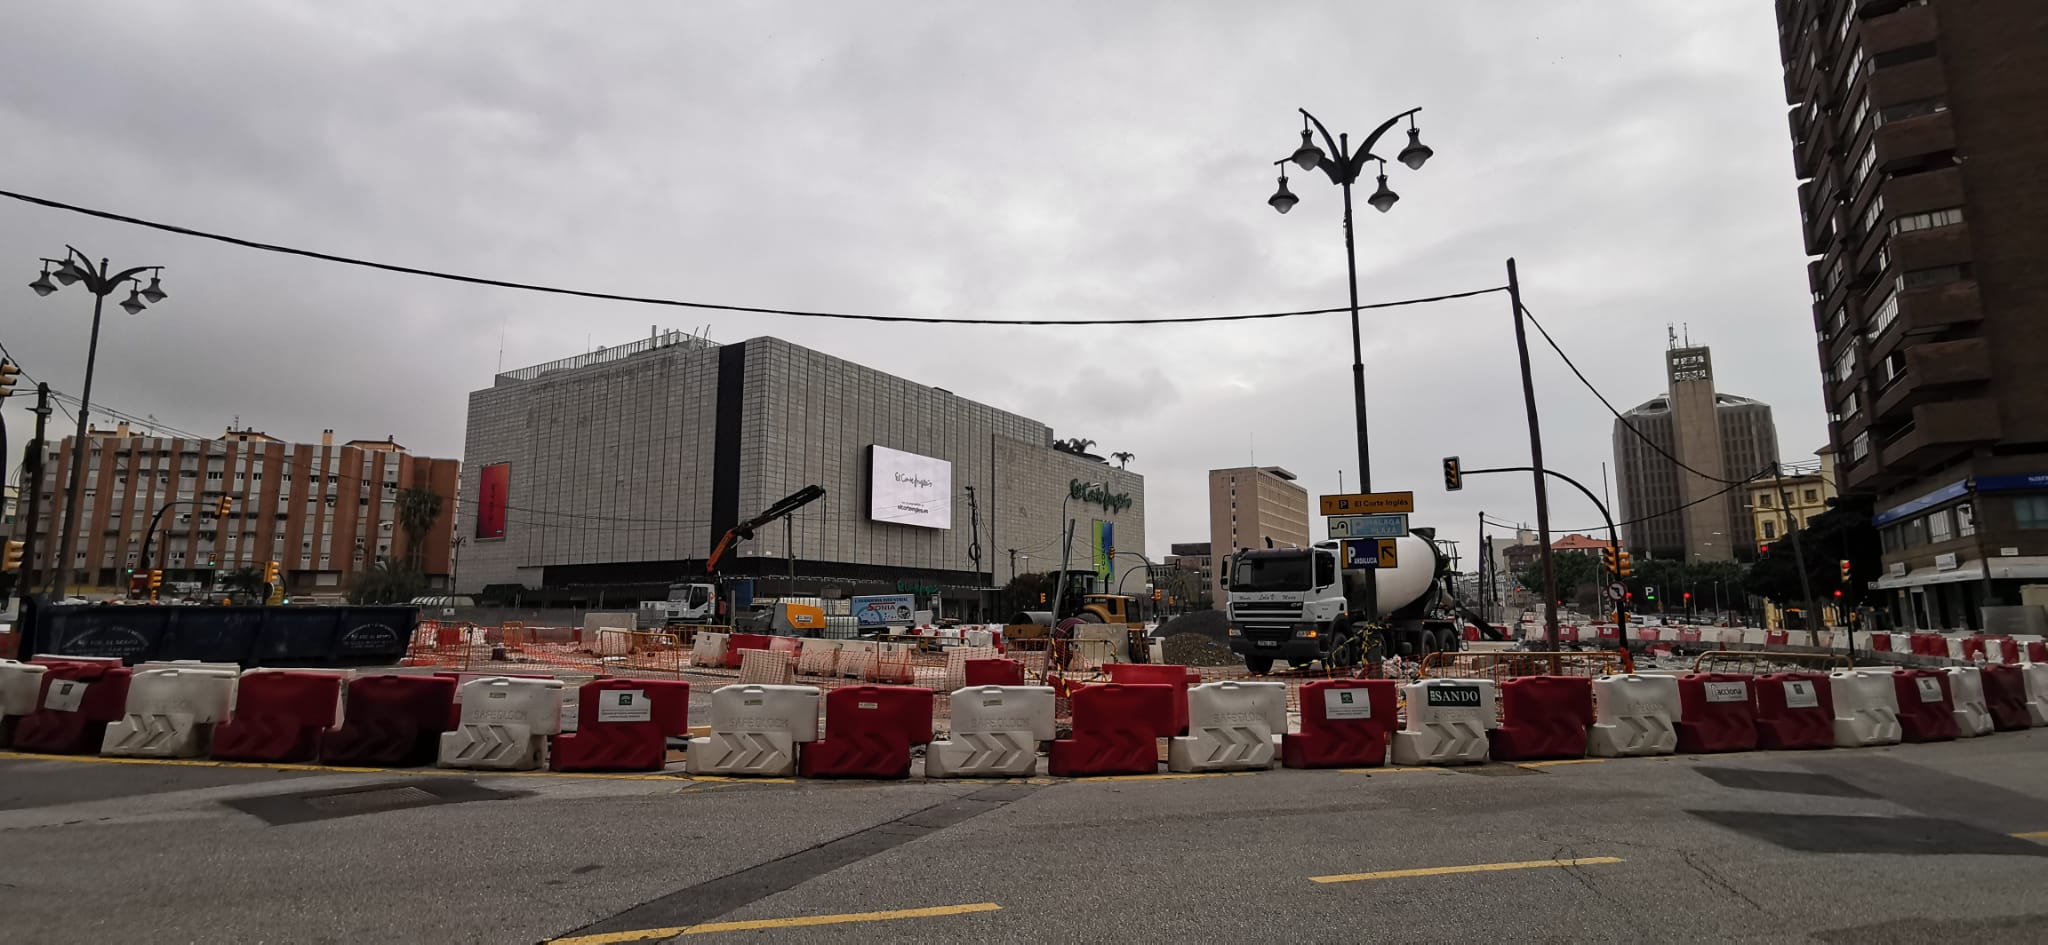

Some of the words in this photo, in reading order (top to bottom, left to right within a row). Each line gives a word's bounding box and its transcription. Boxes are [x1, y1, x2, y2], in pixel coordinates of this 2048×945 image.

[1363, 499, 1384, 507] Corte
[1385, 498, 1409, 506] Inglés
[1348, 546, 1356, 564] P
[1645, 586, 1654, 596] P
[867, 601, 896, 611] SONIA
[1435, 690, 1479, 702] SANDO
